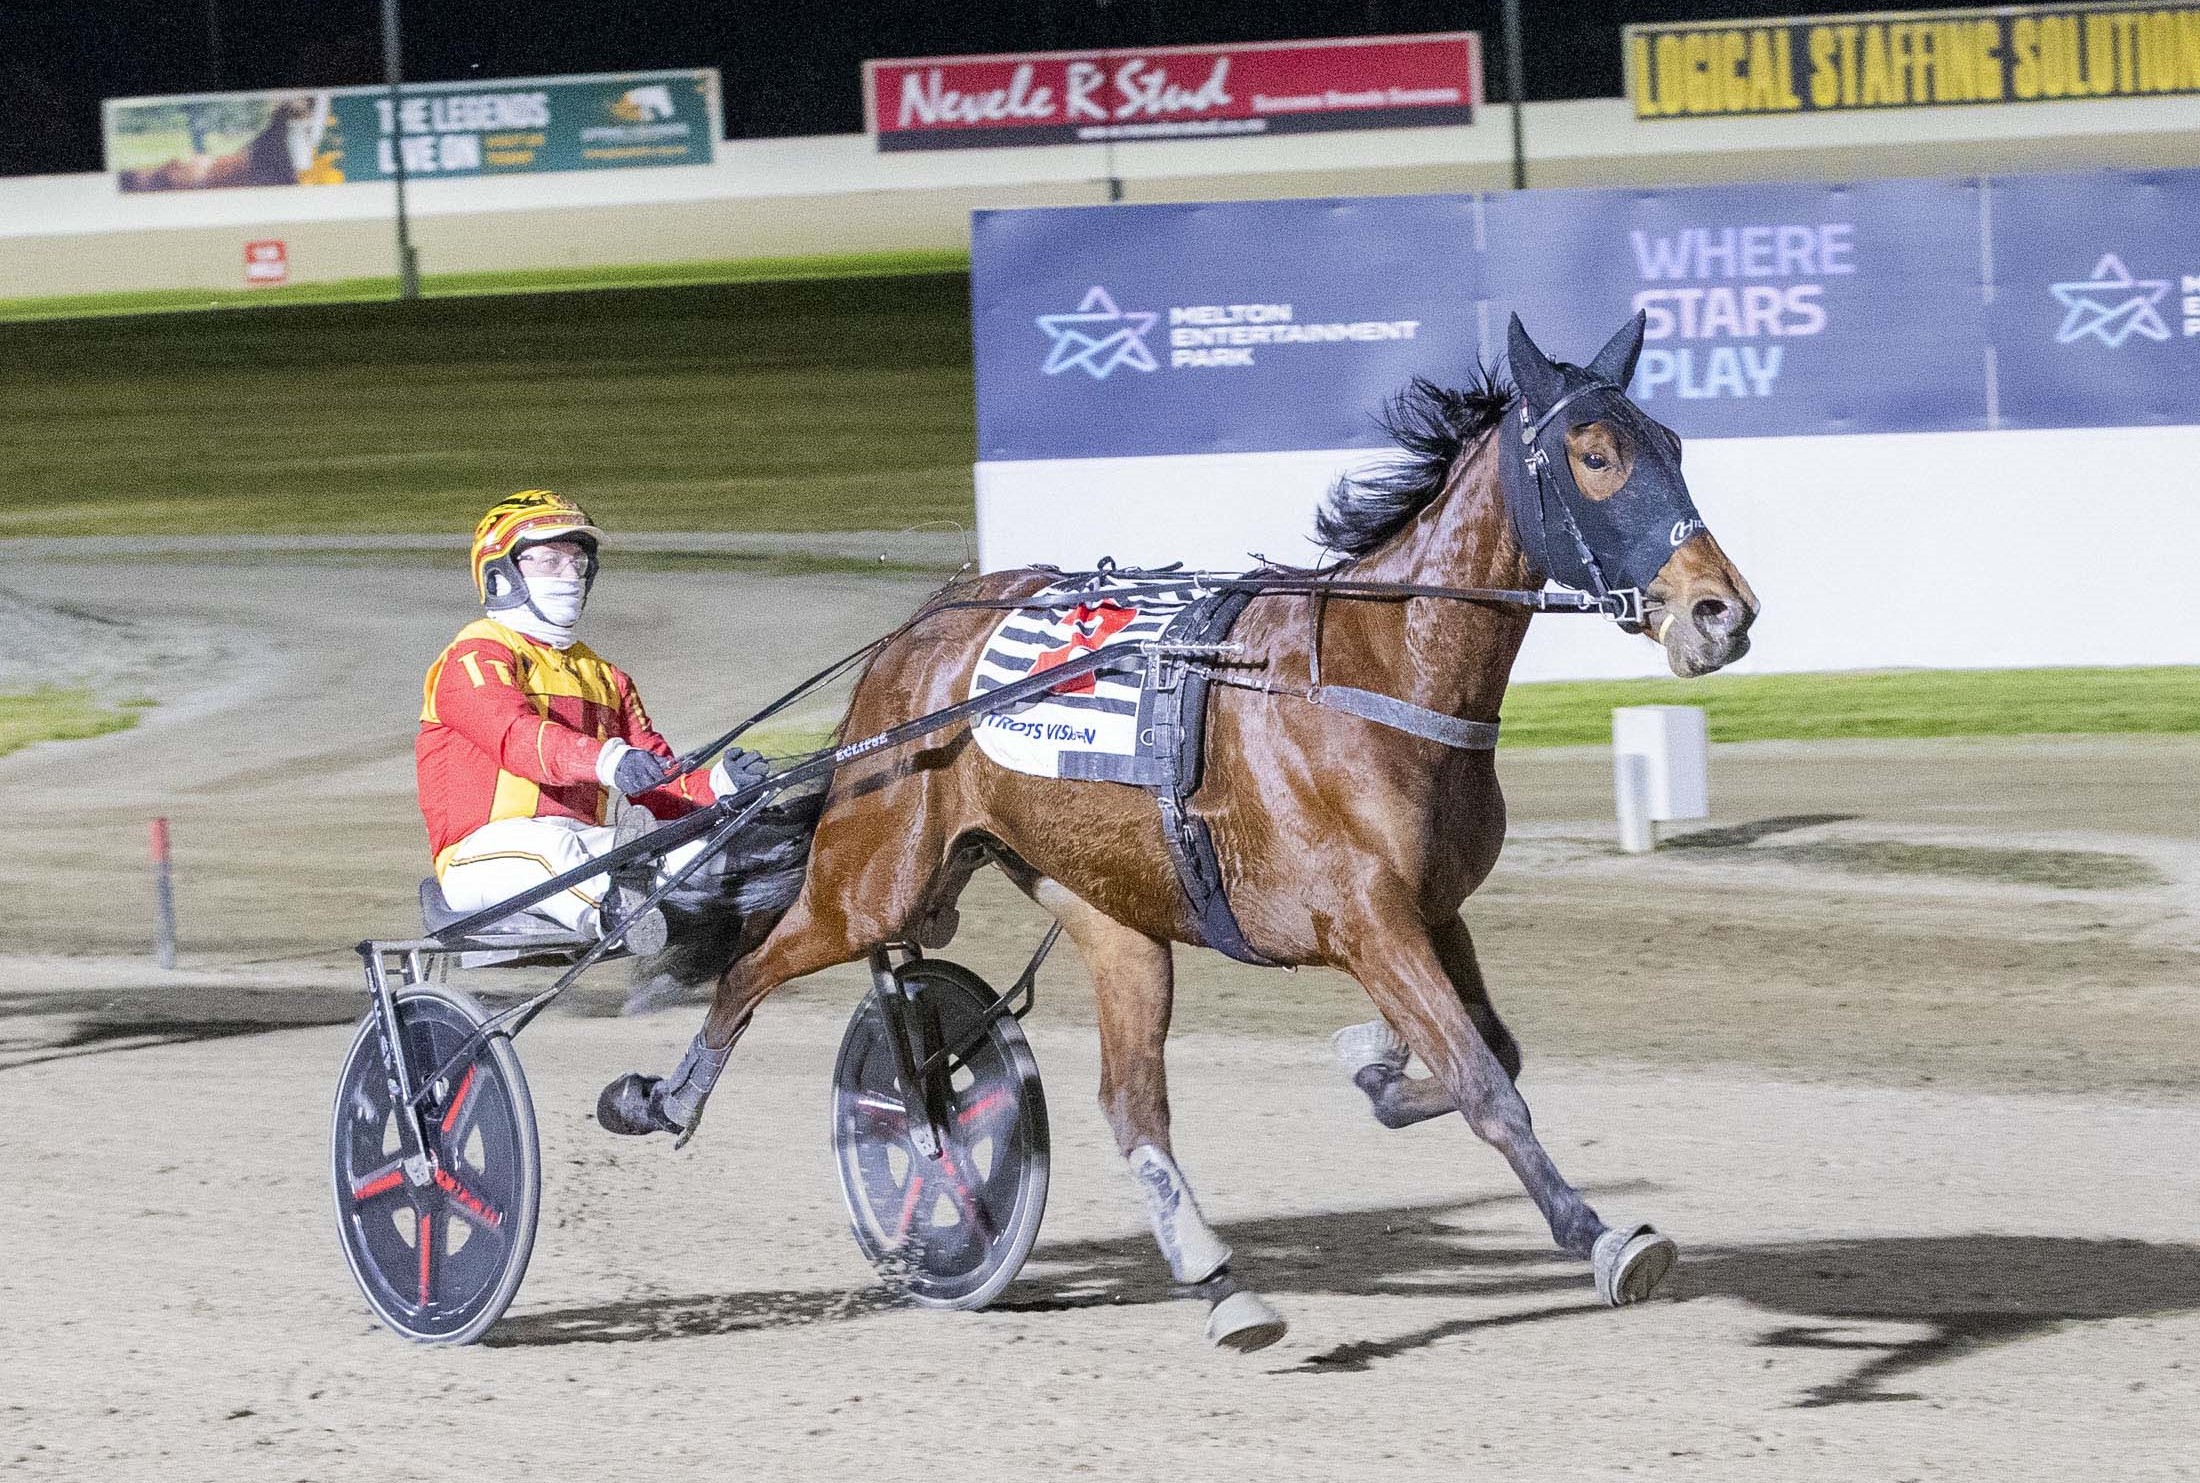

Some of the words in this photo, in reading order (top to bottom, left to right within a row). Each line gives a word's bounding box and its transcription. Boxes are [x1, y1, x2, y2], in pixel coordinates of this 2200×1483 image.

[1065, 60, 1108, 120] R
[1113, 57, 1232, 120] Stud
[1635, 29, 1801, 116] LOGICAL
[1809, 19, 2002, 108] STAFFING
[1631, 224, 1856, 280] WHERE
[1170, 304, 1293, 326] MELTON
[1171, 321, 1420, 347] ENTERTAINMENT
[1634, 284, 1826, 340] STARS
[1171, 348, 1255, 368] PARK
[1634, 346, 1783, 399] PLAY
